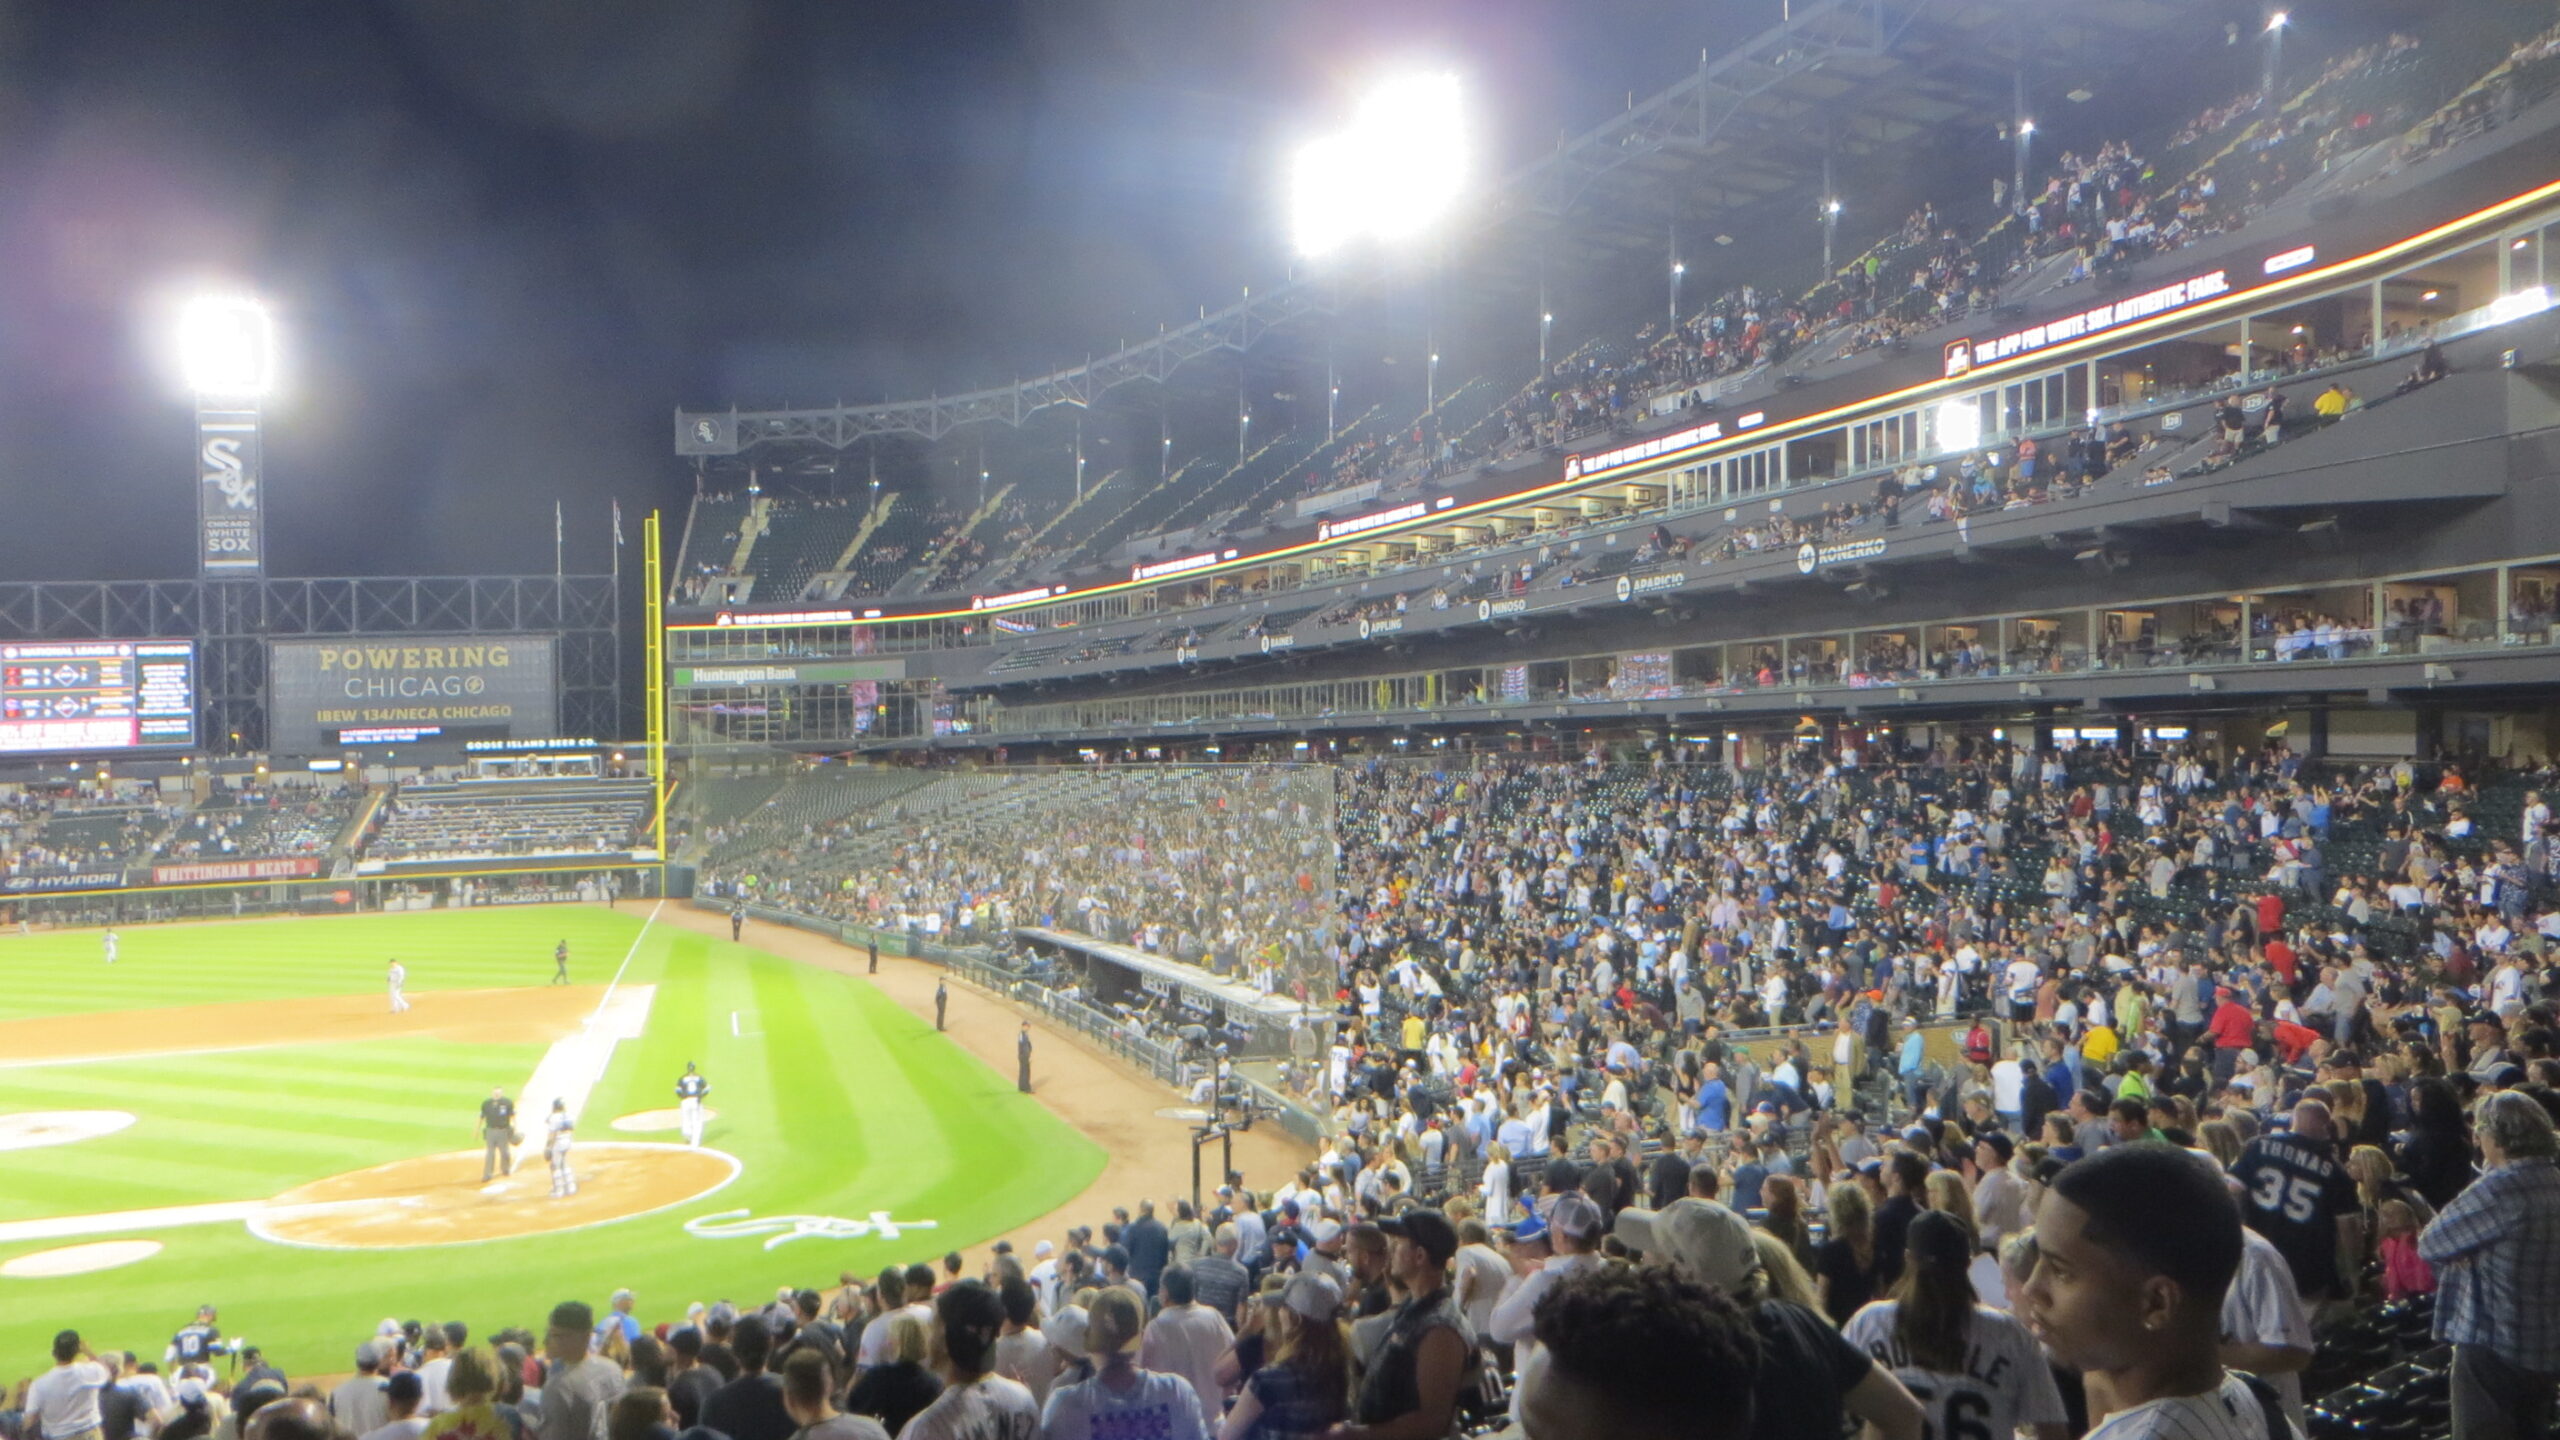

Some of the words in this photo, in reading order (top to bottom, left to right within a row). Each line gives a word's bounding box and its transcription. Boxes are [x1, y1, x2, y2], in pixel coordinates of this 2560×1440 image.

[2046, 313, 2086, 343] WHITE
[2087, 305, 2113, 331] SOX
[207, 520, 250, 528] CHICAGO
[208, 528, 249, 537] WHITE
[208, 538, 250, 551] SOX
[1819, 538, 1887, 563] KONERKO
[1633, 573, 1685, 594] APARICIO
[1370, 620, 1402, 634] APPLING
[319, 646, 510, 671] POWERING
[693, 668, 765, 685] Huntington
[766, 666, 797, 680] Bank
[344, 675, 486, 698] CHICAGO
[317, 709, 357, 723] IBEW
[362, 707, 440, 722] 134/NECA
[442, 705, 512, 720] CHICAGO
[466, 741, 503, 750] GOOSE
[506, 739, 546, 749] ISLAND
[548, 739, 576, 748] BEER
[579, 738, 598, 747] CO.
[38, 873, 117, 887] HYUNDAI
[157, 863, 249, 882] WHITTINGHAM
[255, 861, 296, 876] MEATS
[491, 892, 550, 904] CHICAGO'S
[553, 890, 580, 901] BEER
[2260, 1139, 2334, 1178] THOMAS
[2251, 1166, 2321, 1222] 35
